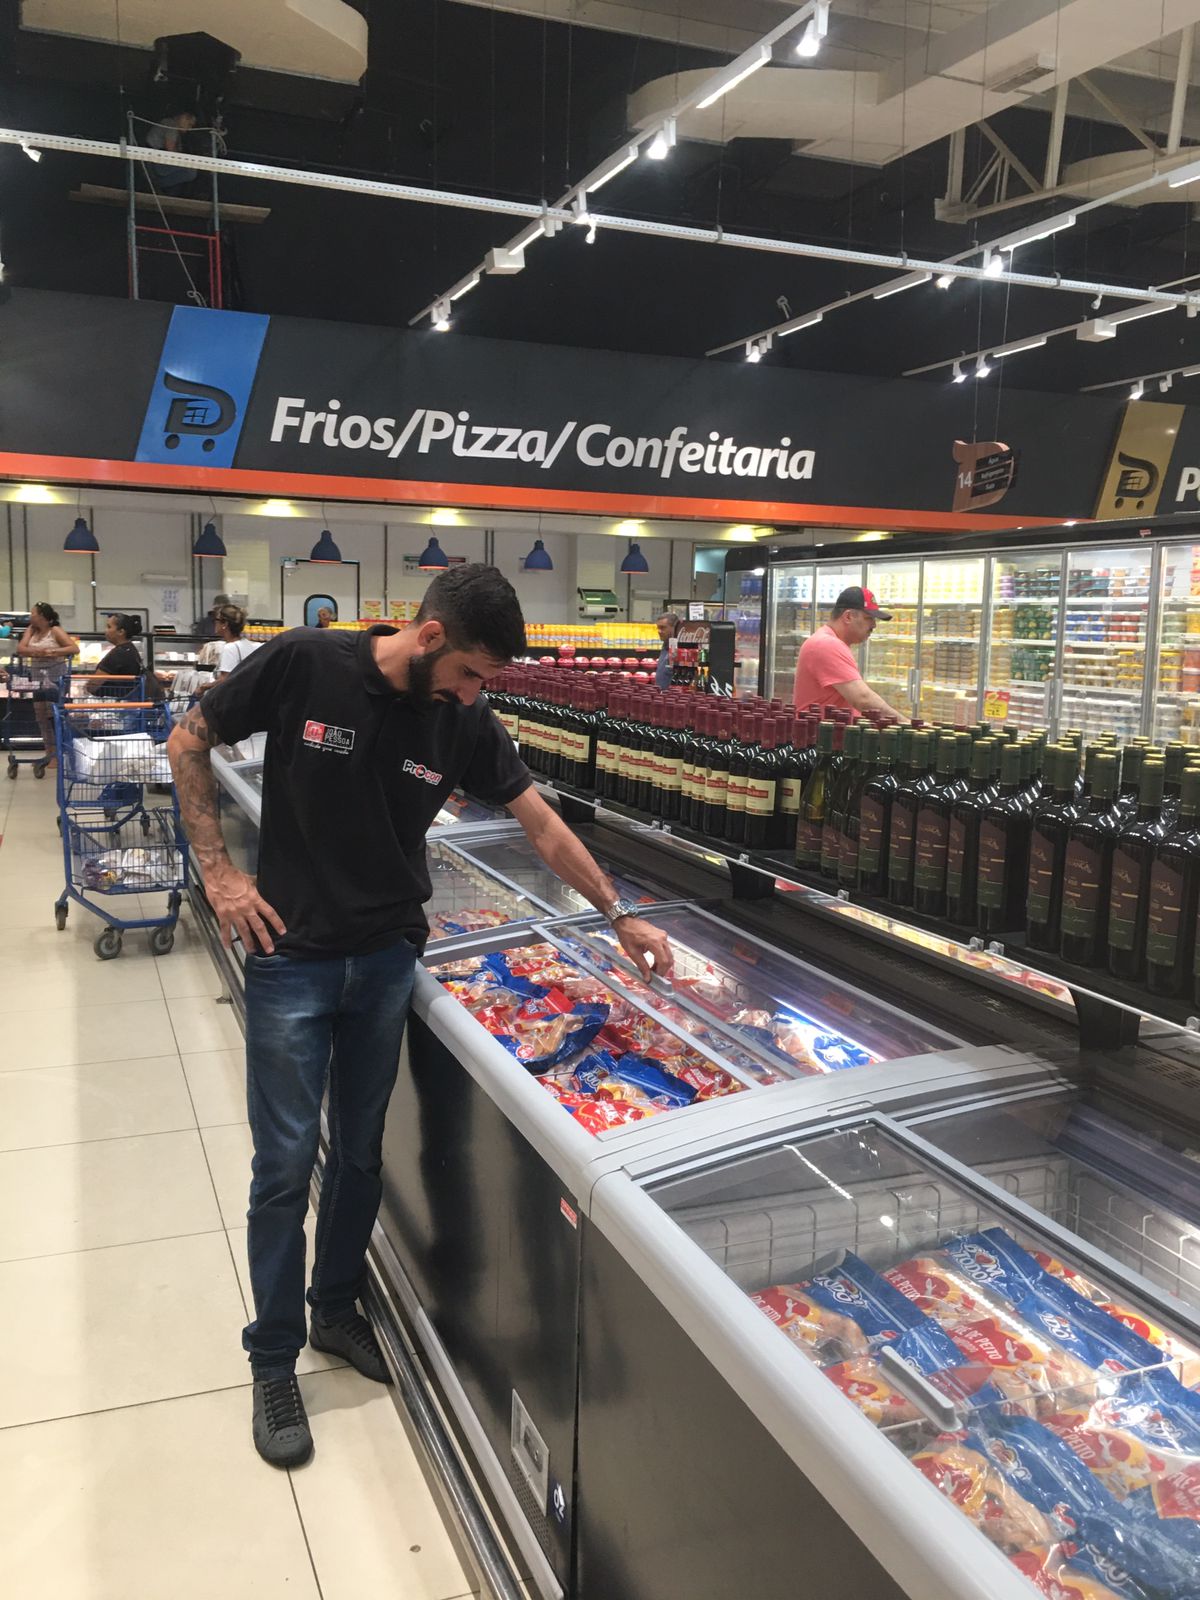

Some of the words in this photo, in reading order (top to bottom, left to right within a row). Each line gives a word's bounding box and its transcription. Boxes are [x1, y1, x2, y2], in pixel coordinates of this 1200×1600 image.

[269, 398, 816, 479] Frios/Pizza/Confeitaria
[958, 471, 973, 489] 14
[1175, 467, 1200, 502] P
[325, 735, 350, 745] PESSOA
[403, 759, 443, 783] Procon
[975, 1335, 1003, 1360] PEITO
[1063, 1431, 1096, 1460] PEITO
